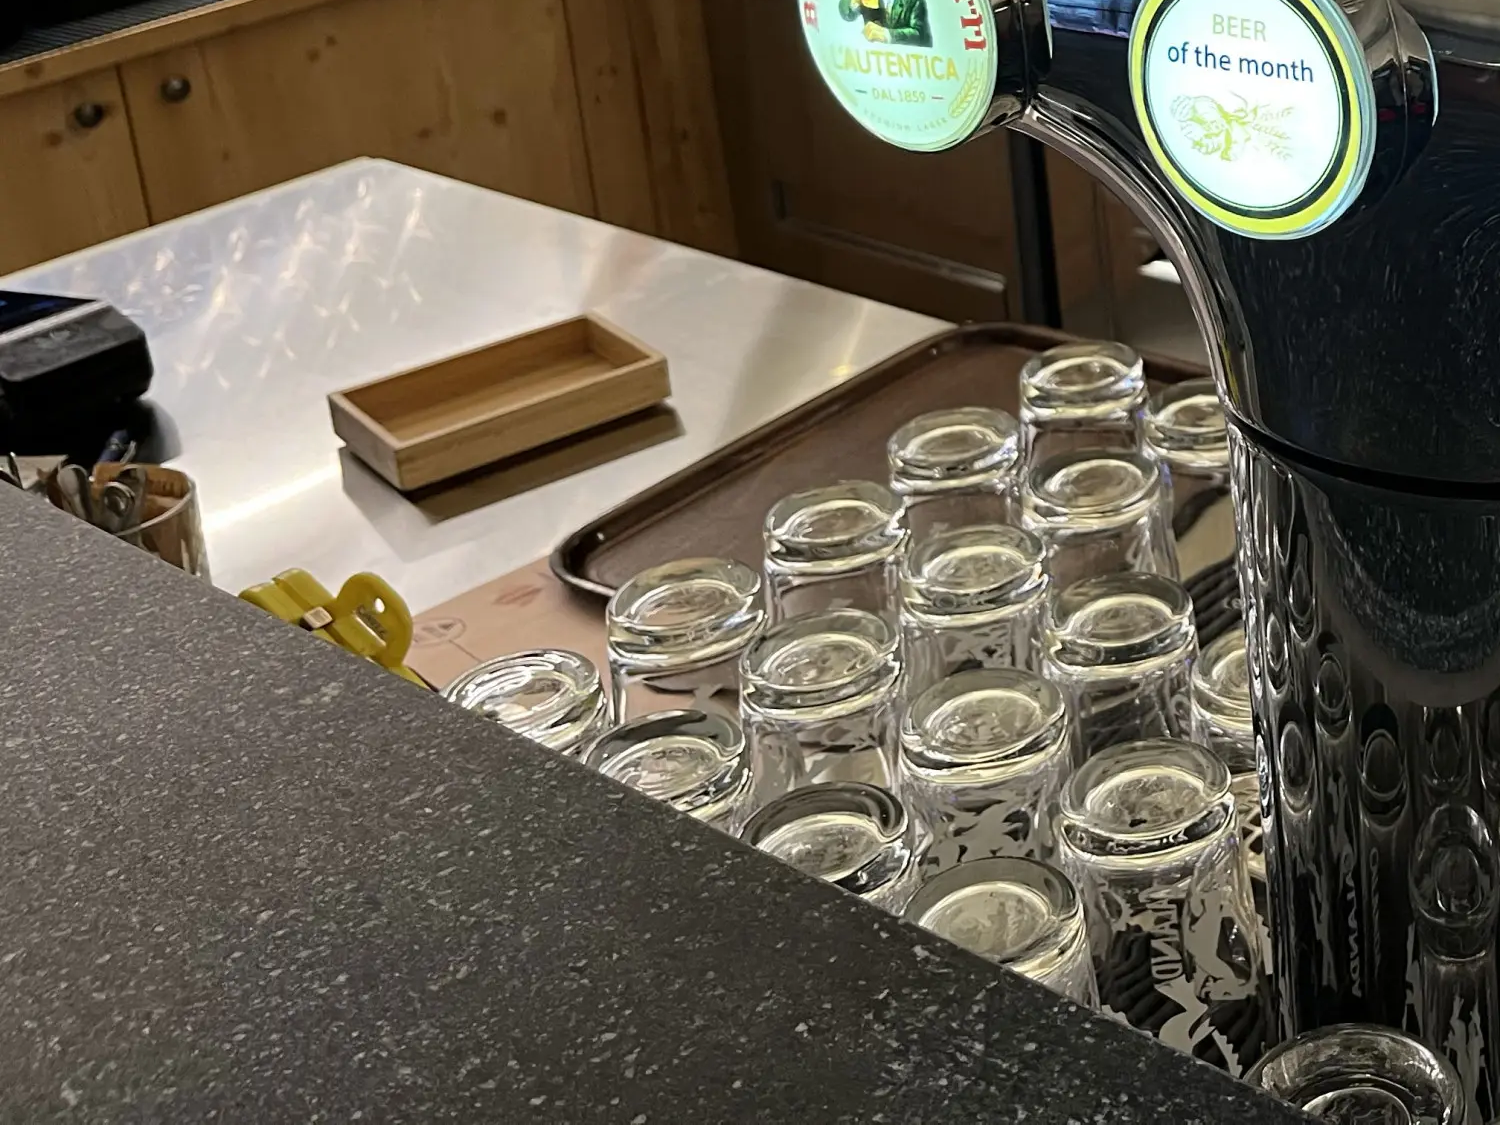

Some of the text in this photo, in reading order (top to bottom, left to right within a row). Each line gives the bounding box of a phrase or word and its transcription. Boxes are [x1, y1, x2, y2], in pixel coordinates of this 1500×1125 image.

[1212, 13, 1267, 43] BEER
[830, 44, 960, 82] L'AUTENTICA
[1168, 41, 1314, 83] of the month
[872, 87, 926, 103] DAL 1859
